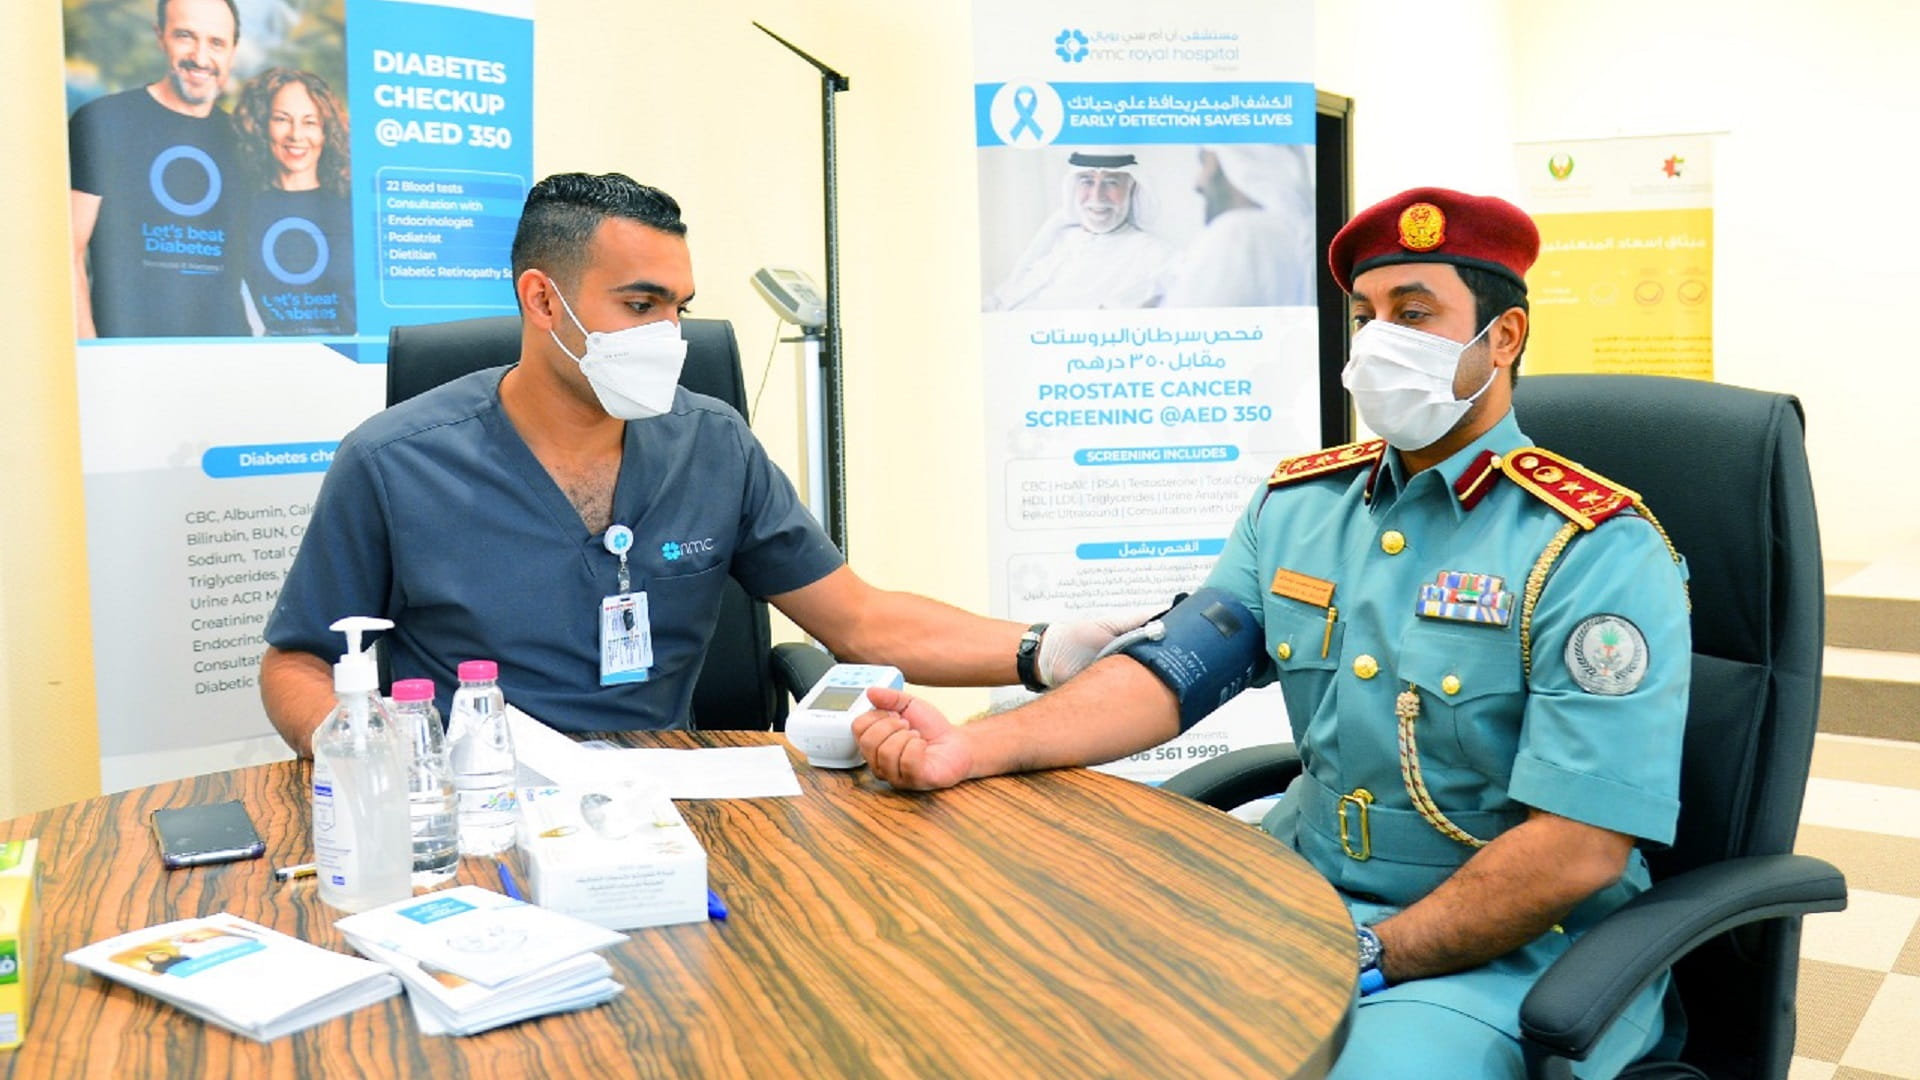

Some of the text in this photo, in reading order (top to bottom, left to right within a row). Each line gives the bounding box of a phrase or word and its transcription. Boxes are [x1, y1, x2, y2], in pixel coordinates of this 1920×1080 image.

[1128, 46, 1168, 63] royal
[1172, 46, 1239, 63] hospital
[373, 49, 507, 84] DIABETES
[374, 84, 505, 116] CHECKUP
[1070, 113, 1293, 127] EARLY DETECTION SAVES LIVES
[375, 118, 512, 150] @AED 350
[386, 180, 464, 195] 22 Blood tests
[387, 198, 484, 212] Consultation with
[388, 214, 474, 229] Endocrinologist
[187, 225, 224, 242] beat
[388, 232, 442, 243] Podiatrist
[145, 238, 222, 257] Diabetes
[389, 249, 437, 261] Dietitian
[390, 266, 436, 278] Diabetic
[438, 267, 500, 281] Retinopathy
[1030, 324, 1263, 348] فحص سرطان البروستات
[1067, 354, 1125, 374] درهم
[1168, 349, 1226, 372] مقابل
[1039, 379, 1252, 401] PROSTATE CANCER
[1025, 405, 1272, 428] SCREENING @AED 350
[239, 452, 307, 467] Diabetes
[1086, 447, 1227, 462] SCREENING INCLUDES
[223, 505, 286, 522] Albumin,
[186, 529, 249, 546] Bilirubin,
[252, 527, 288, 541] BUN,
[252, 547, 286, 561] Total
[679, 538, 714, 556] nmc
[1118, 540, 1199, 558] الفحص يشمل
[190, 594, 229, 610] Urine
[231, 590, 262, 605] ACR
[191, 612, 264, 632] Creatinine
[195, 675, 253, 695] Diabetic
[1155, 747, 1182, 761] 561
[1187, 744, 1230, 759] 9999
